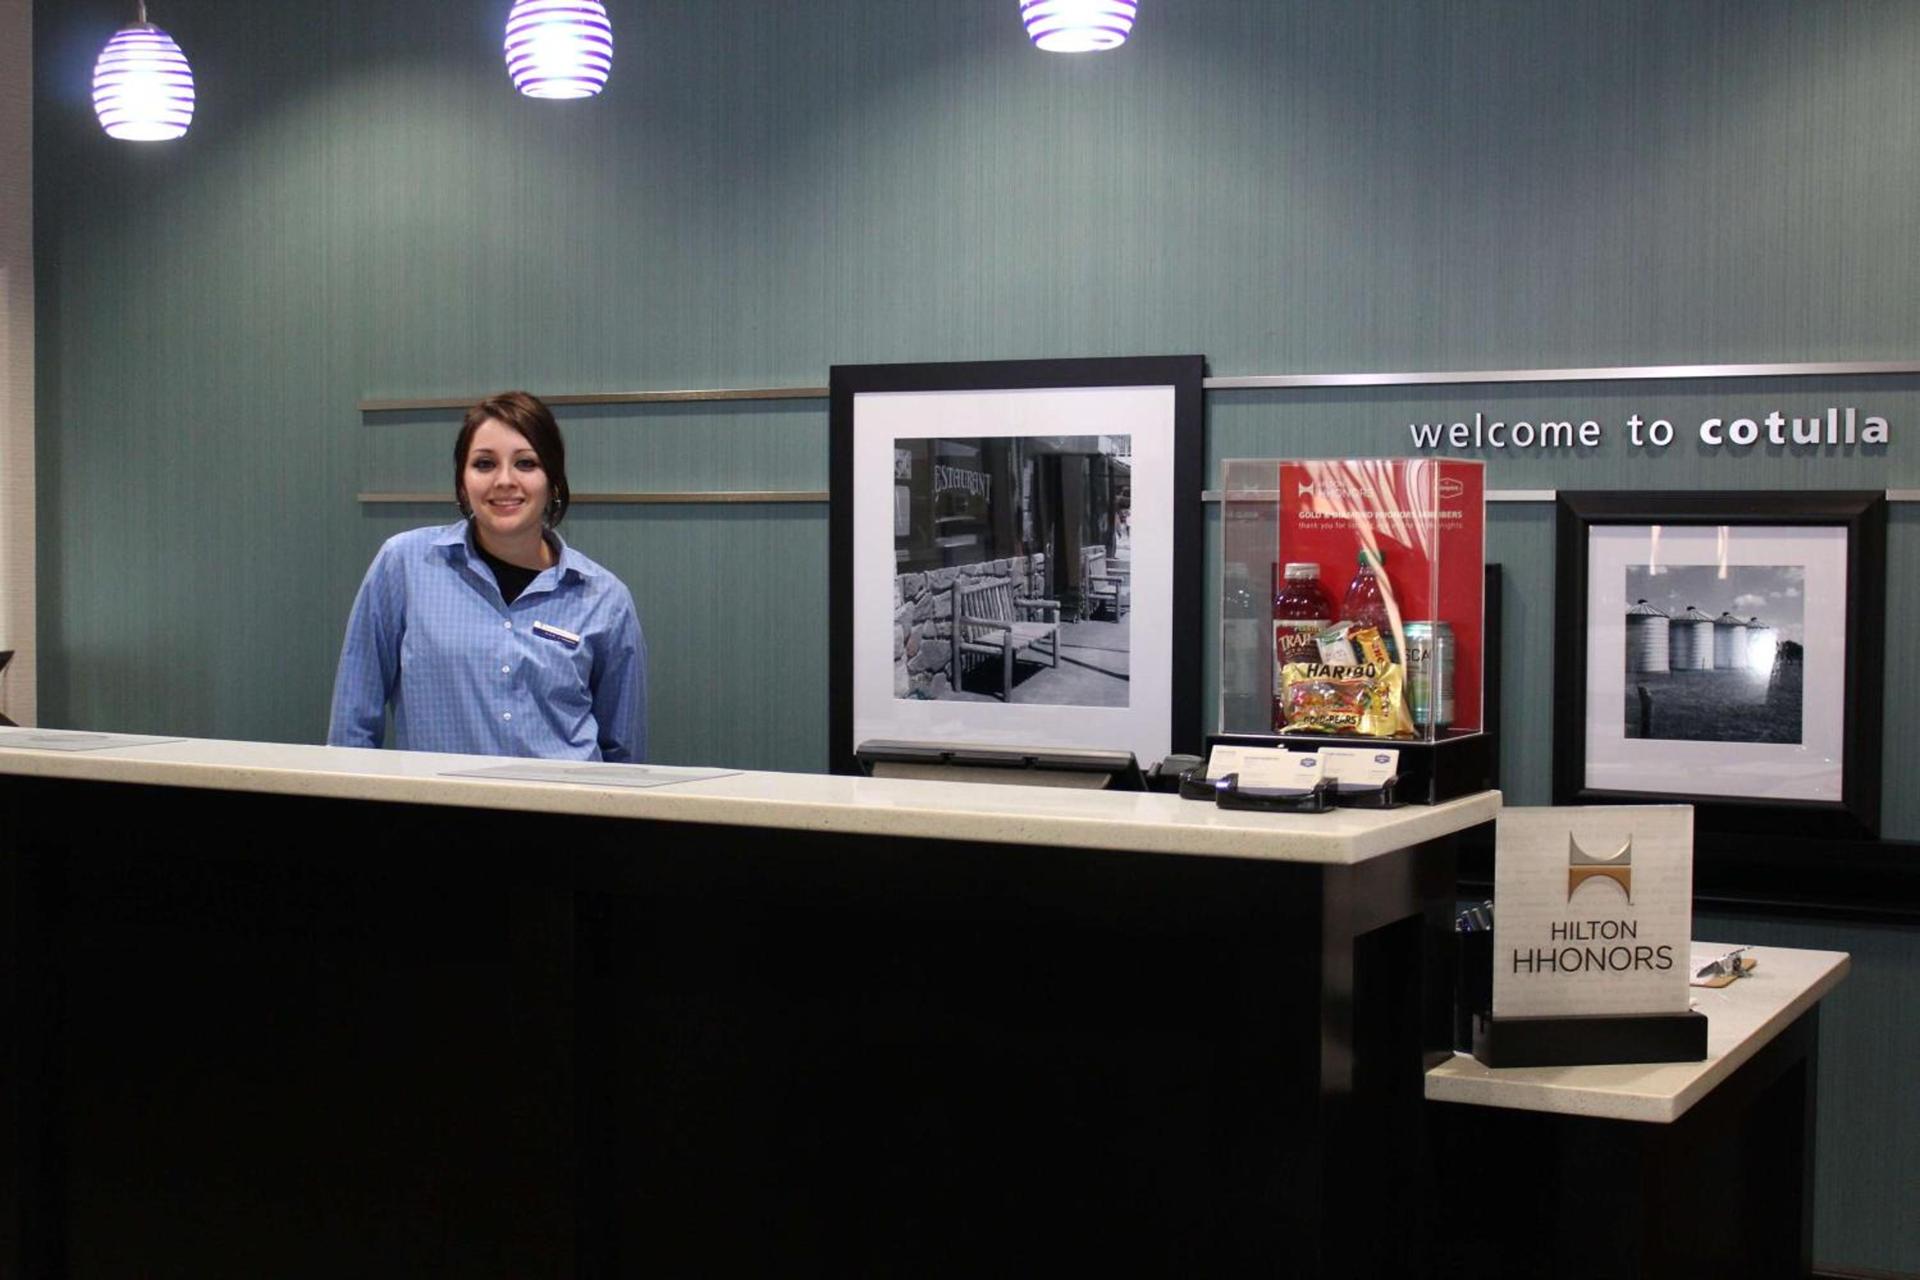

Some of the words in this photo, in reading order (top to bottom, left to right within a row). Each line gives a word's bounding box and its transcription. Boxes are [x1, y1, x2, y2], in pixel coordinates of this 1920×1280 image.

[1409, 412, 1601, 448] welcome
[1626, 414, 1674, 447] to
[1700, 408, 1890, 445] cotulla
[1298, 511, 1321, 519] GOLD
[1307, 662, 1376, 680] HARIBO
[1551, 920, 1637, 941] HILTON
[1513, 945, 1673, 974] HHONORS
